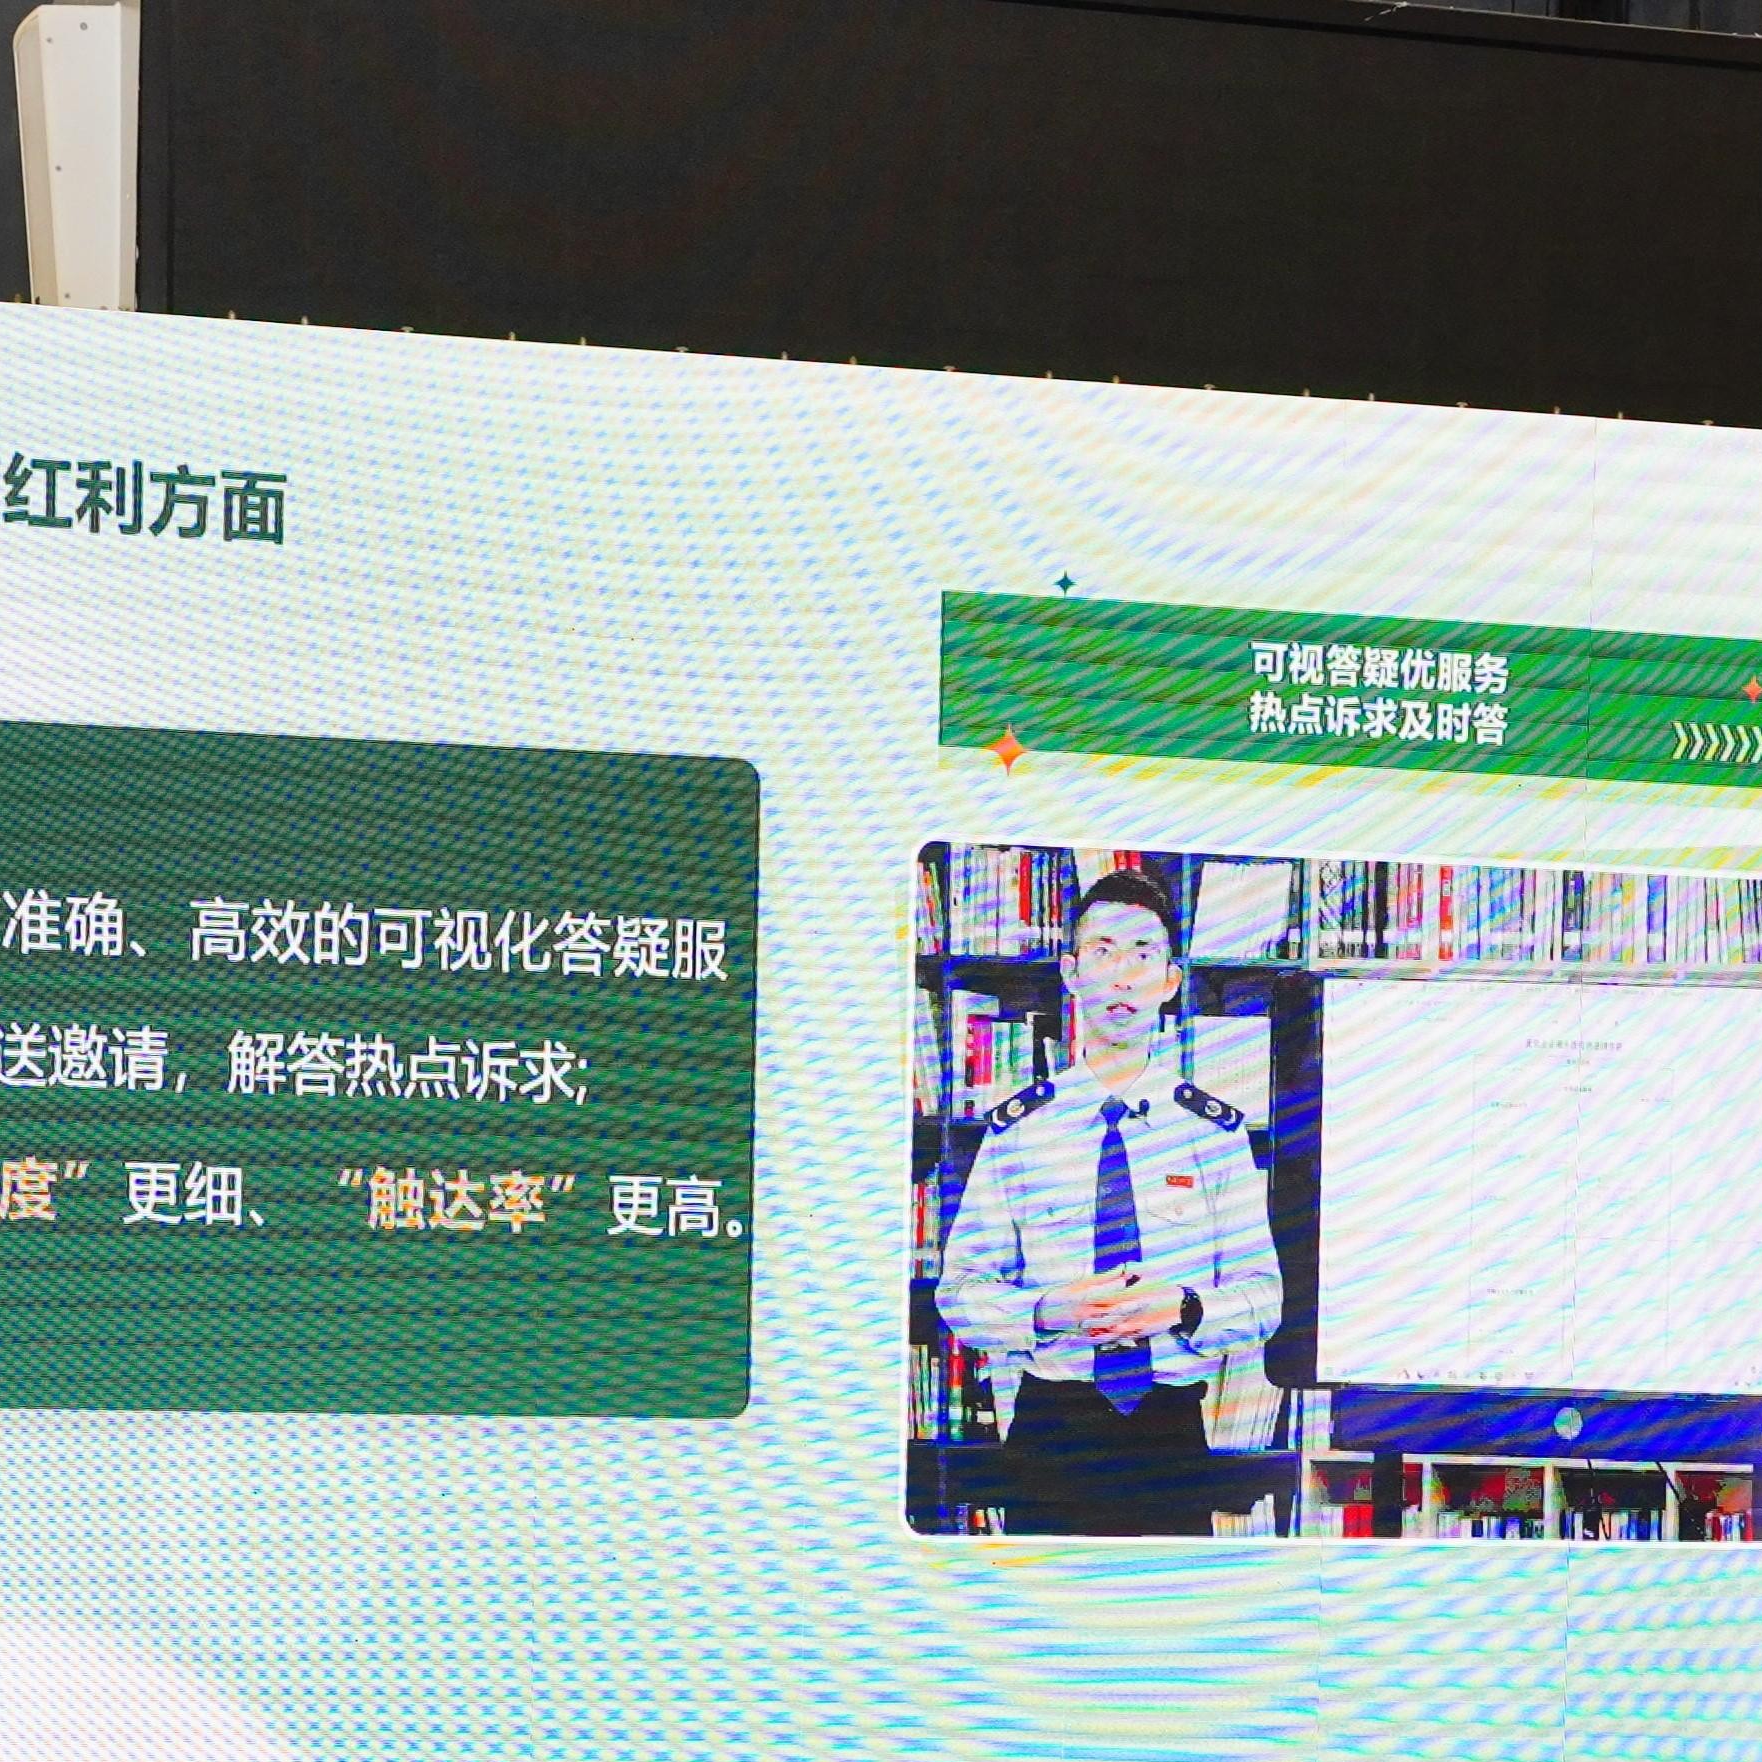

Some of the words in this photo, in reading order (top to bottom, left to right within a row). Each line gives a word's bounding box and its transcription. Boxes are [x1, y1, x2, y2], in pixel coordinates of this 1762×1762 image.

[1250, 641, 1509, 693] 可视答疑优服务
[1248, 694, 1509, 746] 热点诉求及时答
